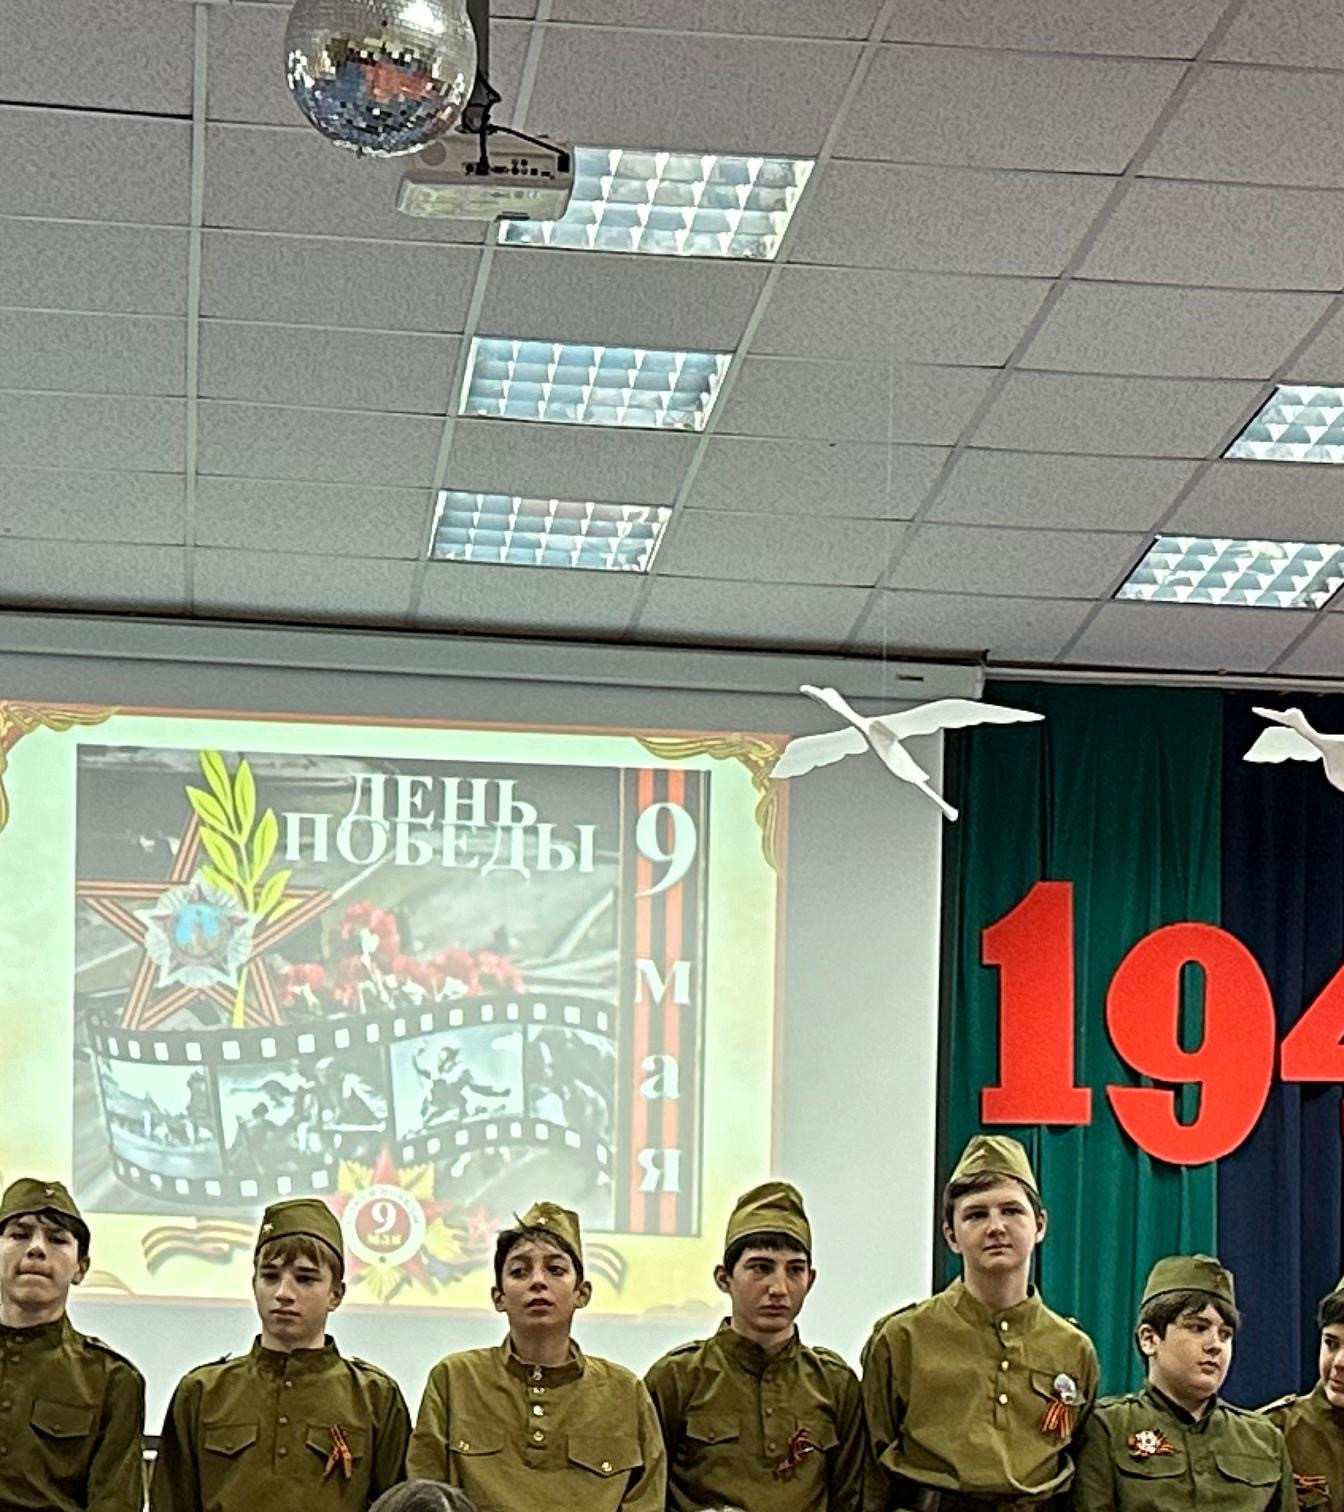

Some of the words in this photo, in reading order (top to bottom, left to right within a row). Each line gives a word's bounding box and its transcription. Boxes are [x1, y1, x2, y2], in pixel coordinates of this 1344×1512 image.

[341, 774, 538, 828] ДЕНЬ
[282, 811, 600, 879] ПОБЕДЫ
[635, 802, 697, 898] 9
[371, 1201, 398, 1235] 9
